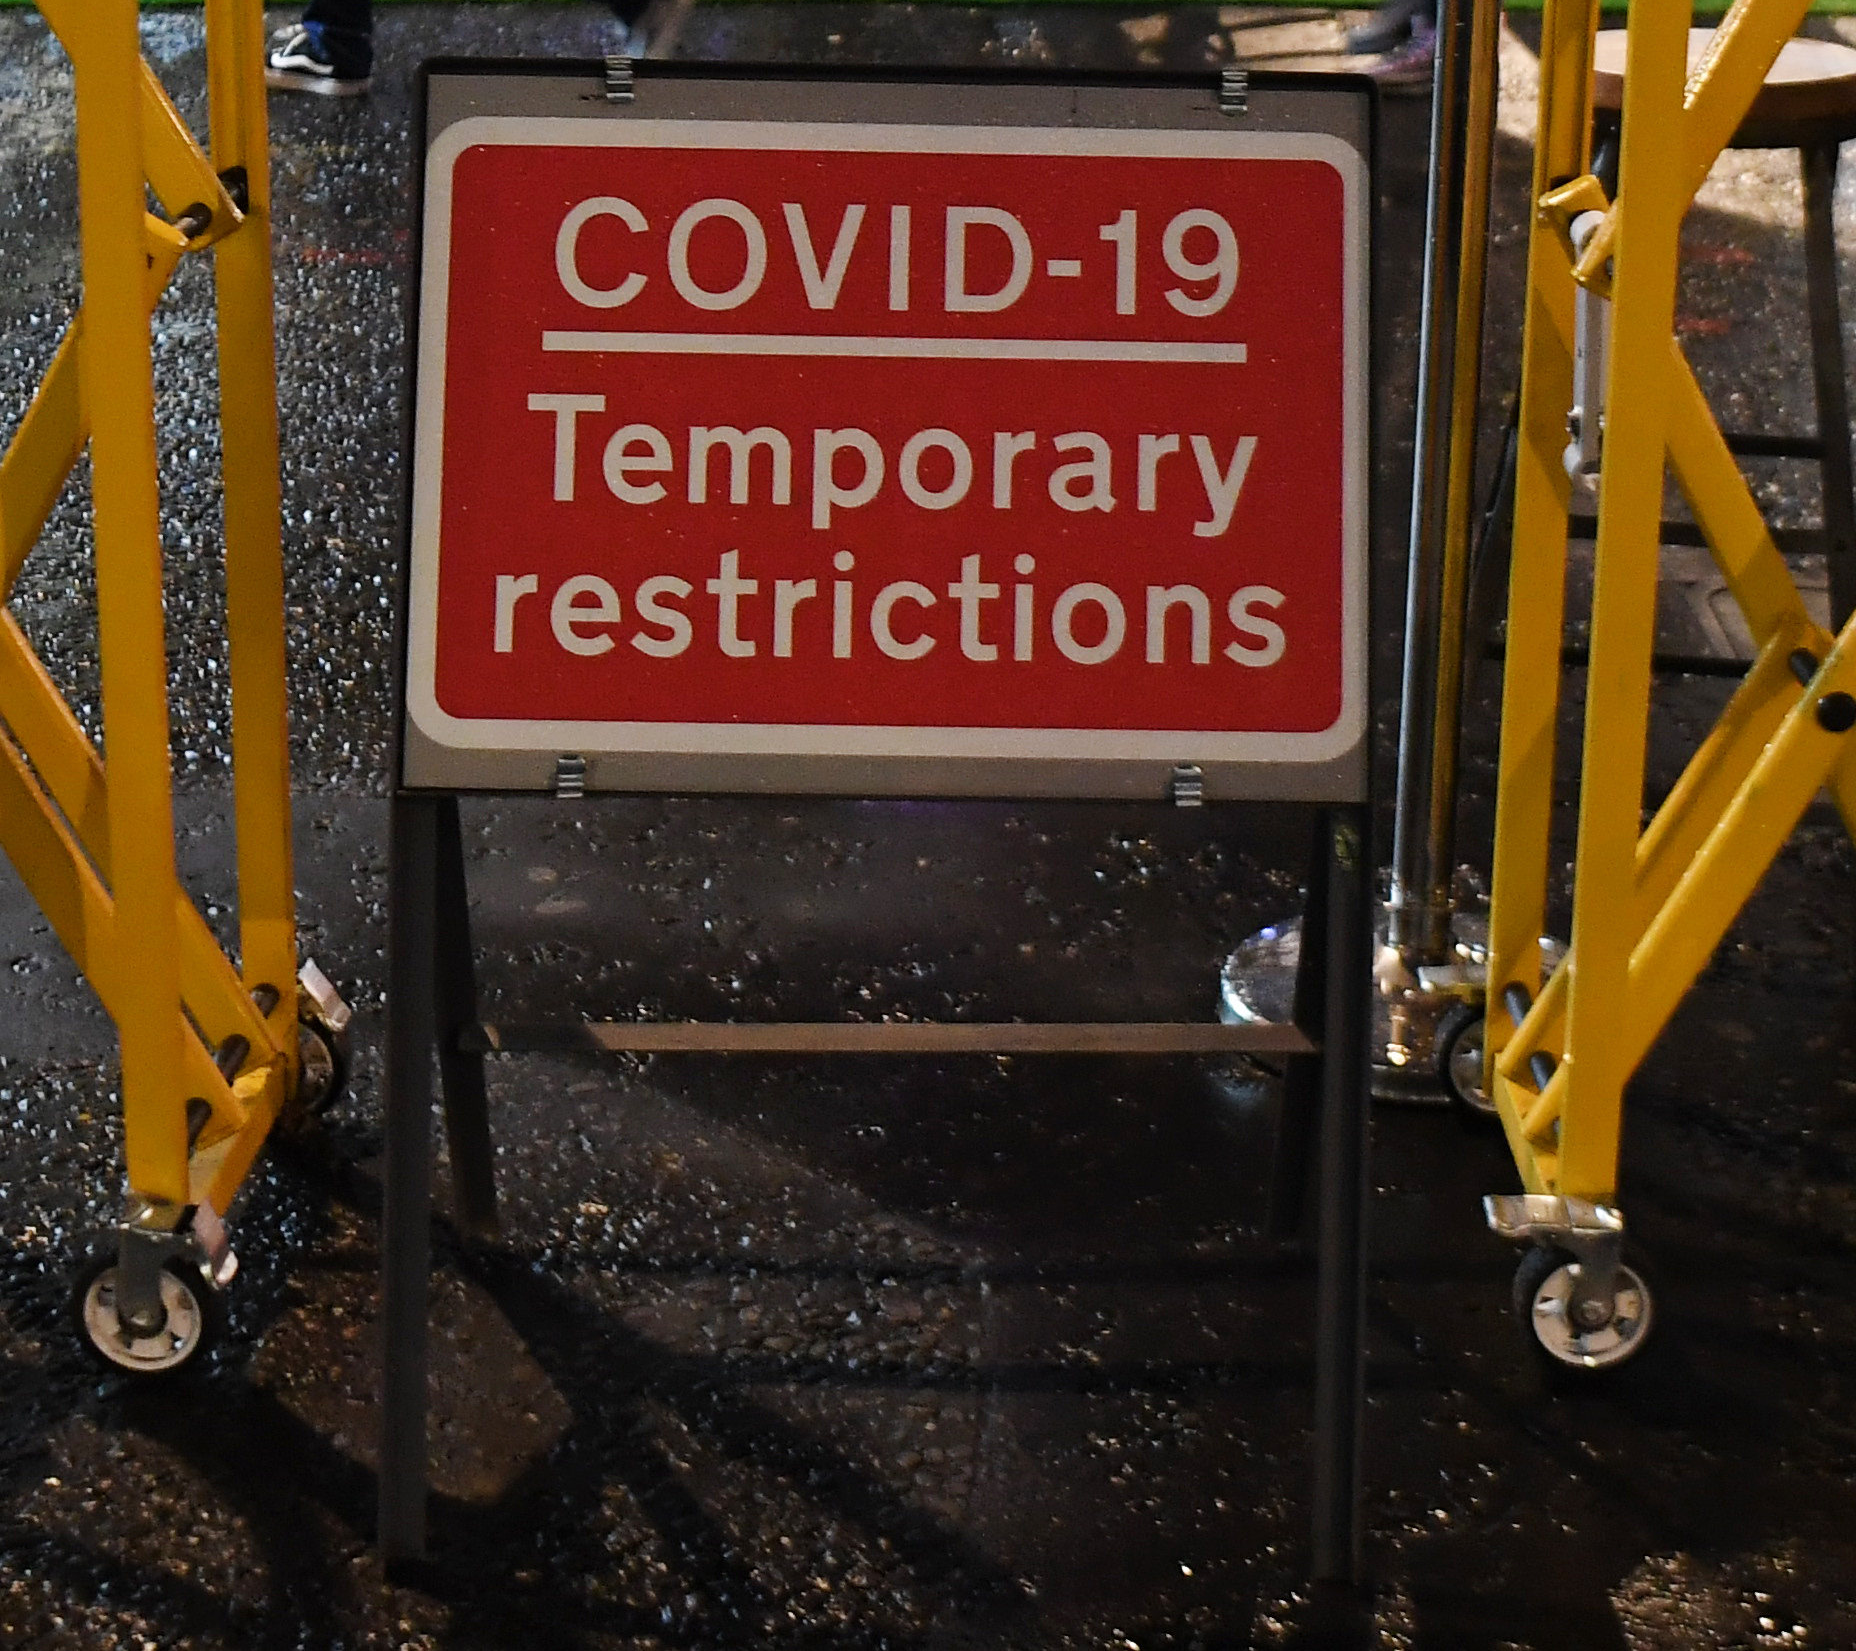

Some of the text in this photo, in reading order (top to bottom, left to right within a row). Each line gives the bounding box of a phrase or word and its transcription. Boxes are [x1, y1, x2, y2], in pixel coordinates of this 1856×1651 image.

[554, 195, 1241, 317] COVID-19
[527, 392, 1257, 538] Temporary
[493, 550, 1288, 667] restrictions
